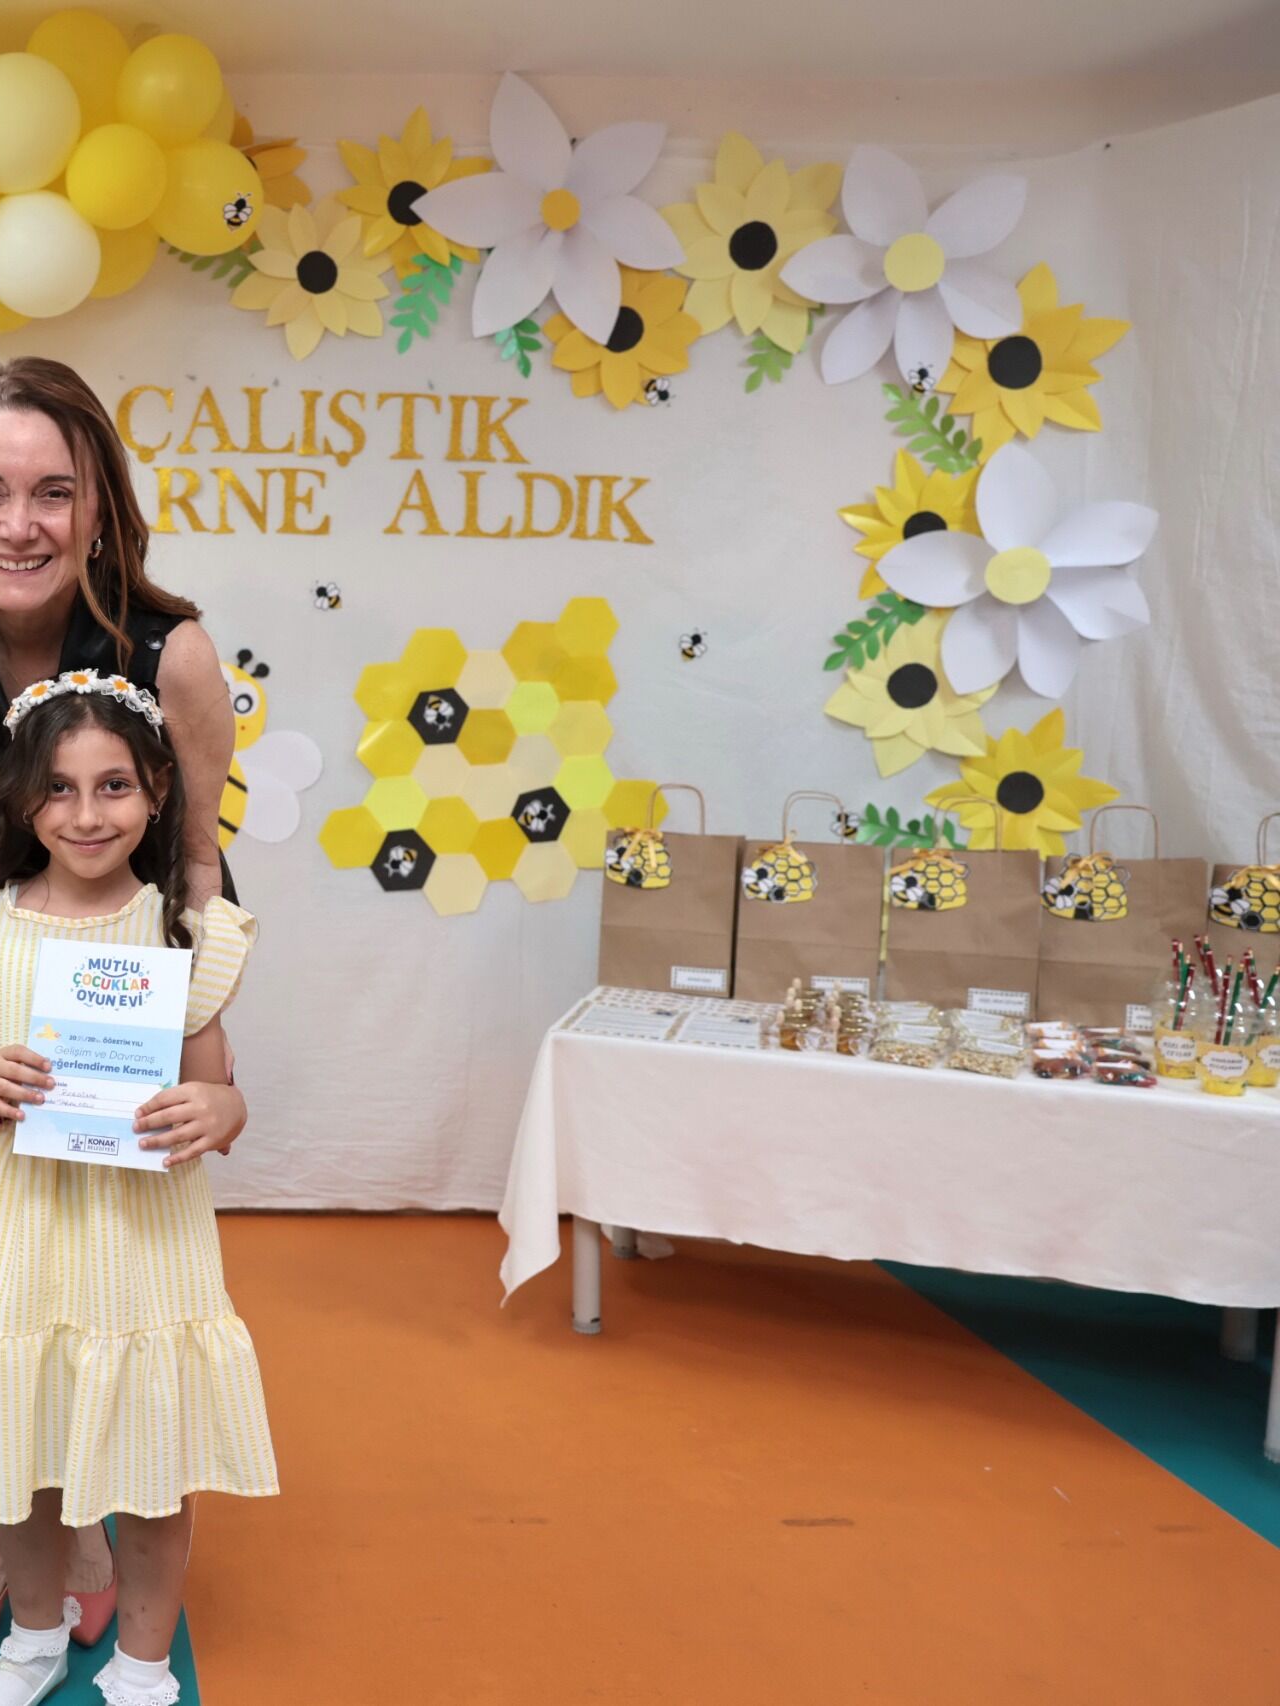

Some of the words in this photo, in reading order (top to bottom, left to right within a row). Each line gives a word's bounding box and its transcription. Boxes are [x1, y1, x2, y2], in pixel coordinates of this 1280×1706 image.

[115, 385, 531, 467] ÇALIŞTIK
[149, 467, 331, 536] RNE
[382, 468, 656, 545] ALDIK
[88, 958, 141, 974] MUTLU
[72, 972, 150, 991] ÇOCUKLAR
[76, 989, 117, 1007] OYUN
[119, 991, 143, 1008] EVİ
[54, 1045, 92, 1058] Gelişim
[94, 1051, 107, 1059] ve
[109, 1050, 156, 1064] Davranış
[51, 1058, 121, 1074] eğerlendirme
[122, 1064, 163, 1077] Karnesi
[87, 1138, 116, 1148] KONAK
